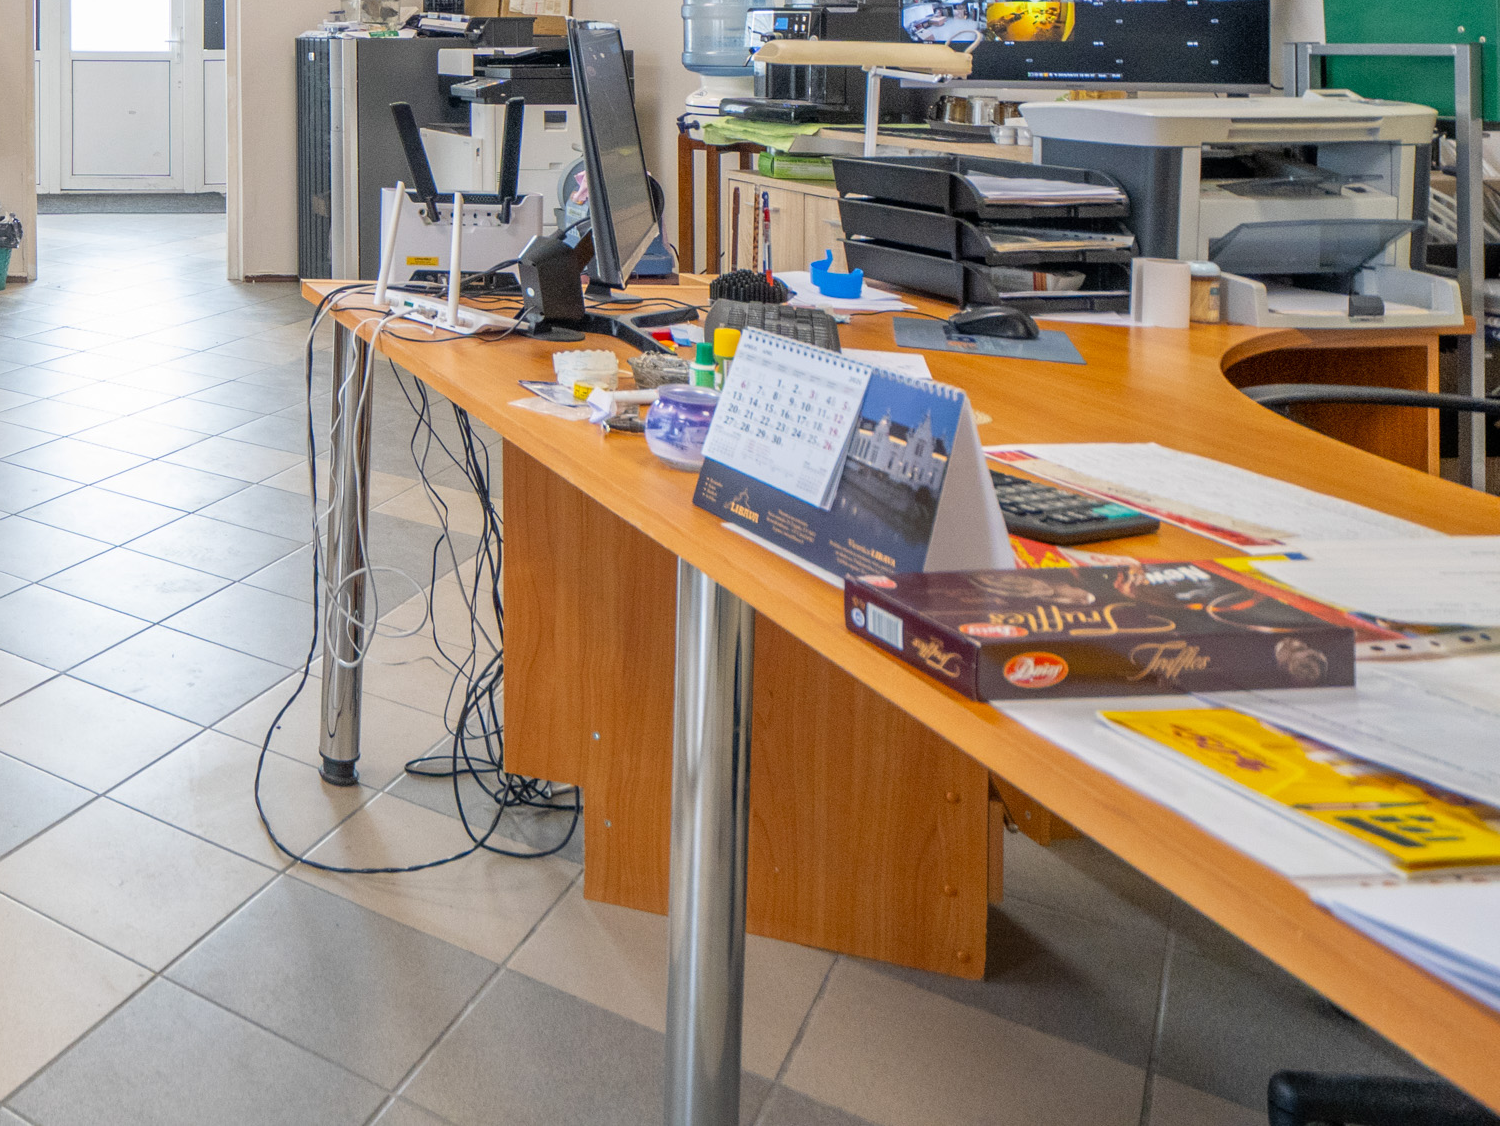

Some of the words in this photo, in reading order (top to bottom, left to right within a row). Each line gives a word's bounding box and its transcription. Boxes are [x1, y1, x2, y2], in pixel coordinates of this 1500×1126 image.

[732, 392, 742, 401] 13
[749, 397, 758, 407] 14
[765, 404, 774, 413] 15
[780, 409, 790, 419] 16
[796, 415, 806, 425] 17
[813, 421, 823, 431] 18
[828, 426, 838, 436] 19
[741, 381, 746, 389] 6
[758, 386, 763, 394] 7
[773, 392, 778, 400] 8
[789, 397, 794, 406] 9
[801, 402, 811, 412] 10
[818, 408, 827, 418] 11
[834, 414, 844, 424] 12
[809, 390, 815, 398] 3
[827, 396, 832, 404] 4
[842, 402, 848, 410] 5
[724, 416, 734, 425] 27
[740, 422, 750, 432] 28
[756, 428, 766, 438] 29
[771, 434, 782, 445] 30
[728, 404, 738, 414] 20
[744, 409, 753, 420] 21
[760, 416, 770, 426] 22
[775, 422, 786, 432] 23
[791, 428, 802, 438] 24
[807, 434, 817, 444] 25
[823, 440, 832, 451] 26
[730, 501, 759, 524] LIBAVA
[989, 602, 1176, 636] Truffles
[912, 634, 962, 678] Truffles
[1010, 657, 1063, 681] Daisy
[1126, 640, 1211, 680] Truffles
